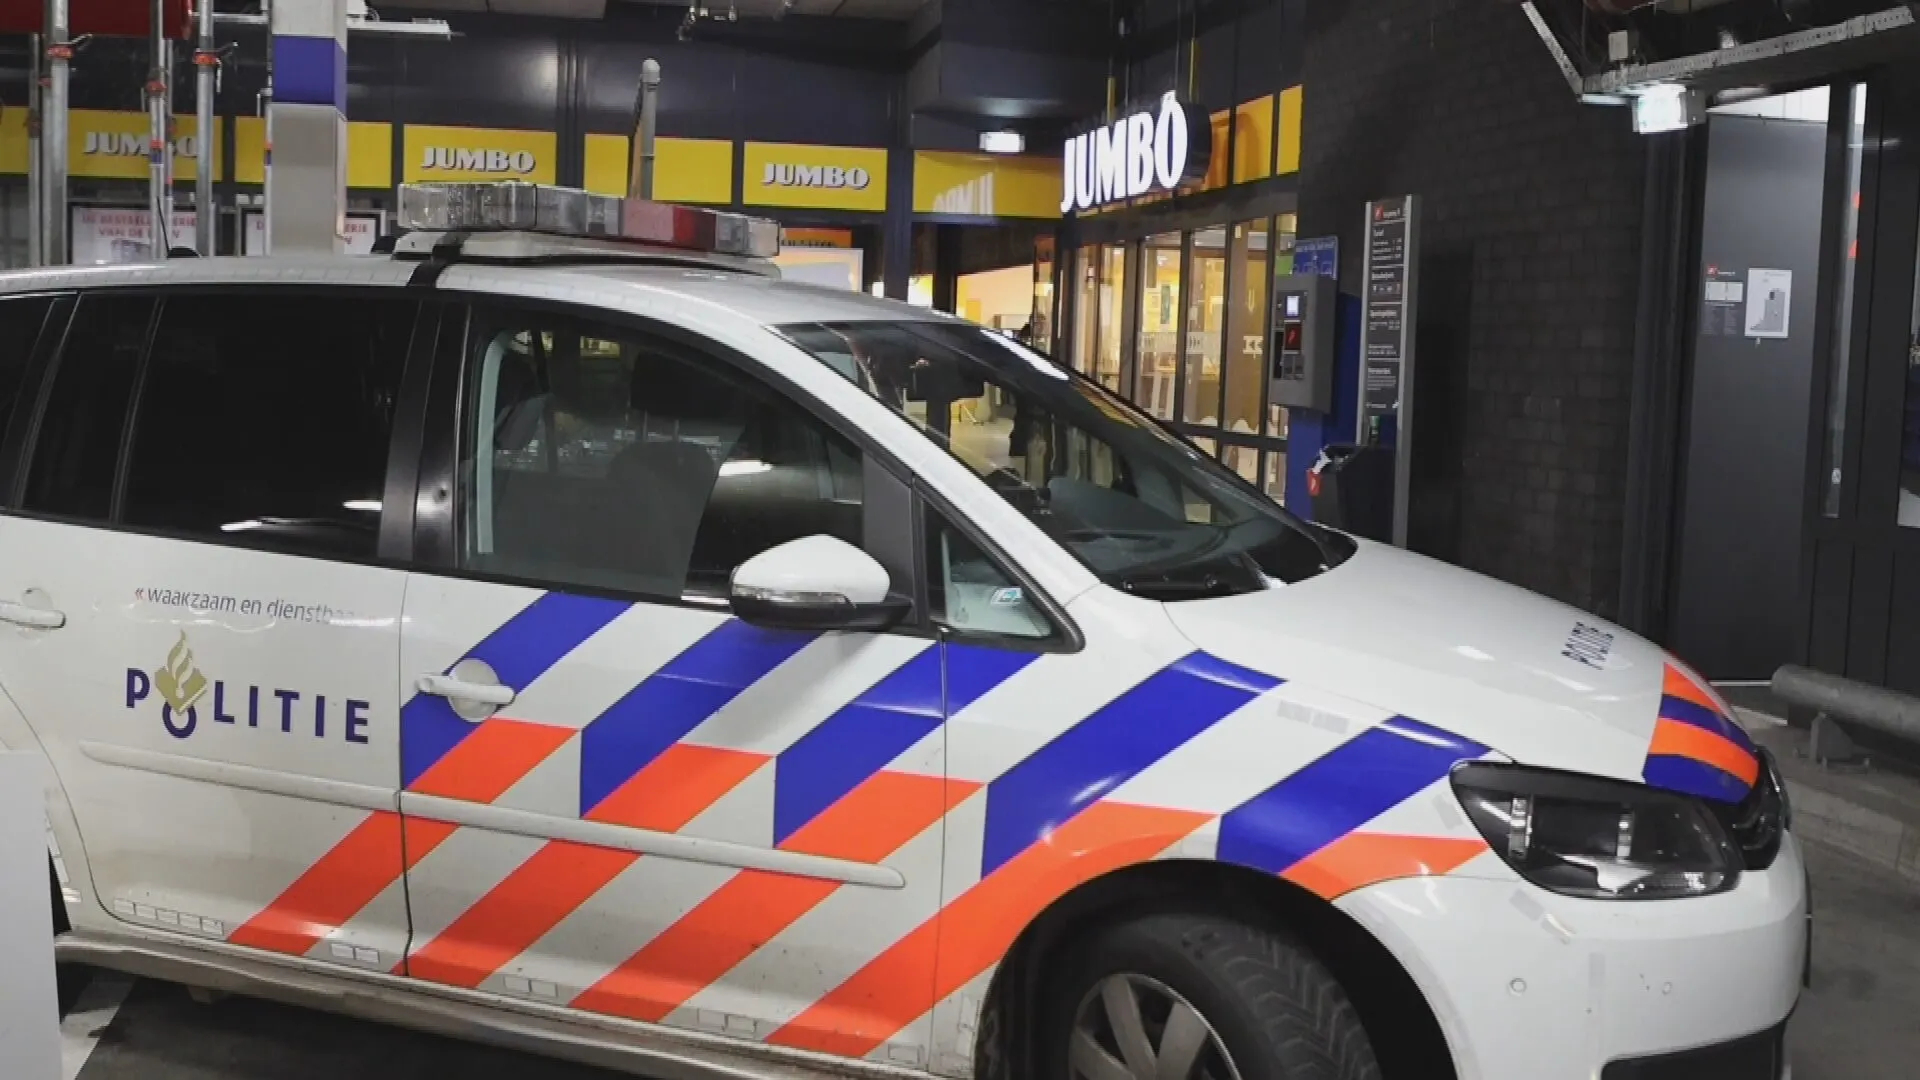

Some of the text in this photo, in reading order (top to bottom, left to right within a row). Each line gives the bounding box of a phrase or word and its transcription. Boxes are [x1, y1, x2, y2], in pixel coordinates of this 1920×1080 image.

[83, 131, 200, 157] JUMO
[1060, 91, 1187, 213] JUMBO
[420, 147, 536, 174] JUMBO
[762, 163, 870, 190] JUMBO
[148, 588, 236, 613] waakzaam
[240, 599, 261, 614] en
[126, 667, 370, 745] POLITIE
